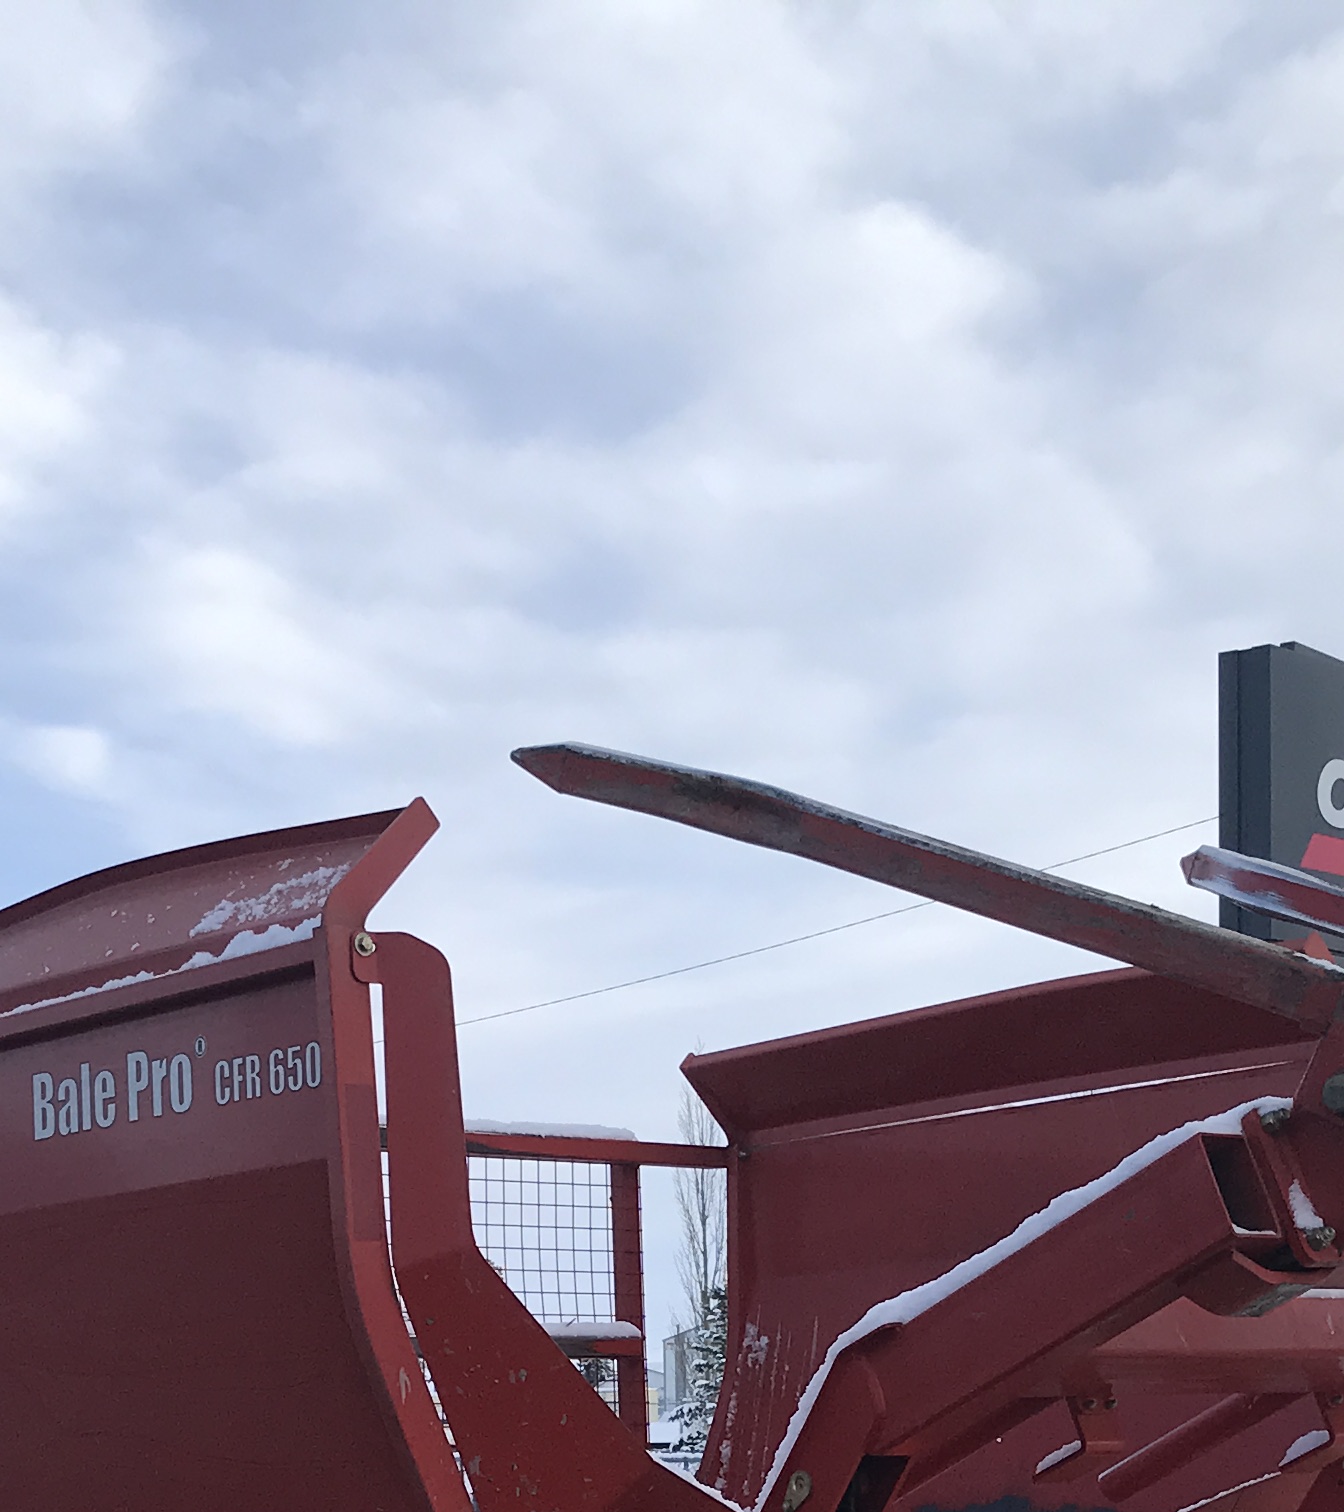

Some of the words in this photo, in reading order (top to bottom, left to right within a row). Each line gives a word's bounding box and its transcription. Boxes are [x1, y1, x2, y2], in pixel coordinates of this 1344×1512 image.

[31, 1062, 116, 1142] Bale
[214, 1054, 262, 1106] CFR
[268, 1039, 323, 1096] 650
